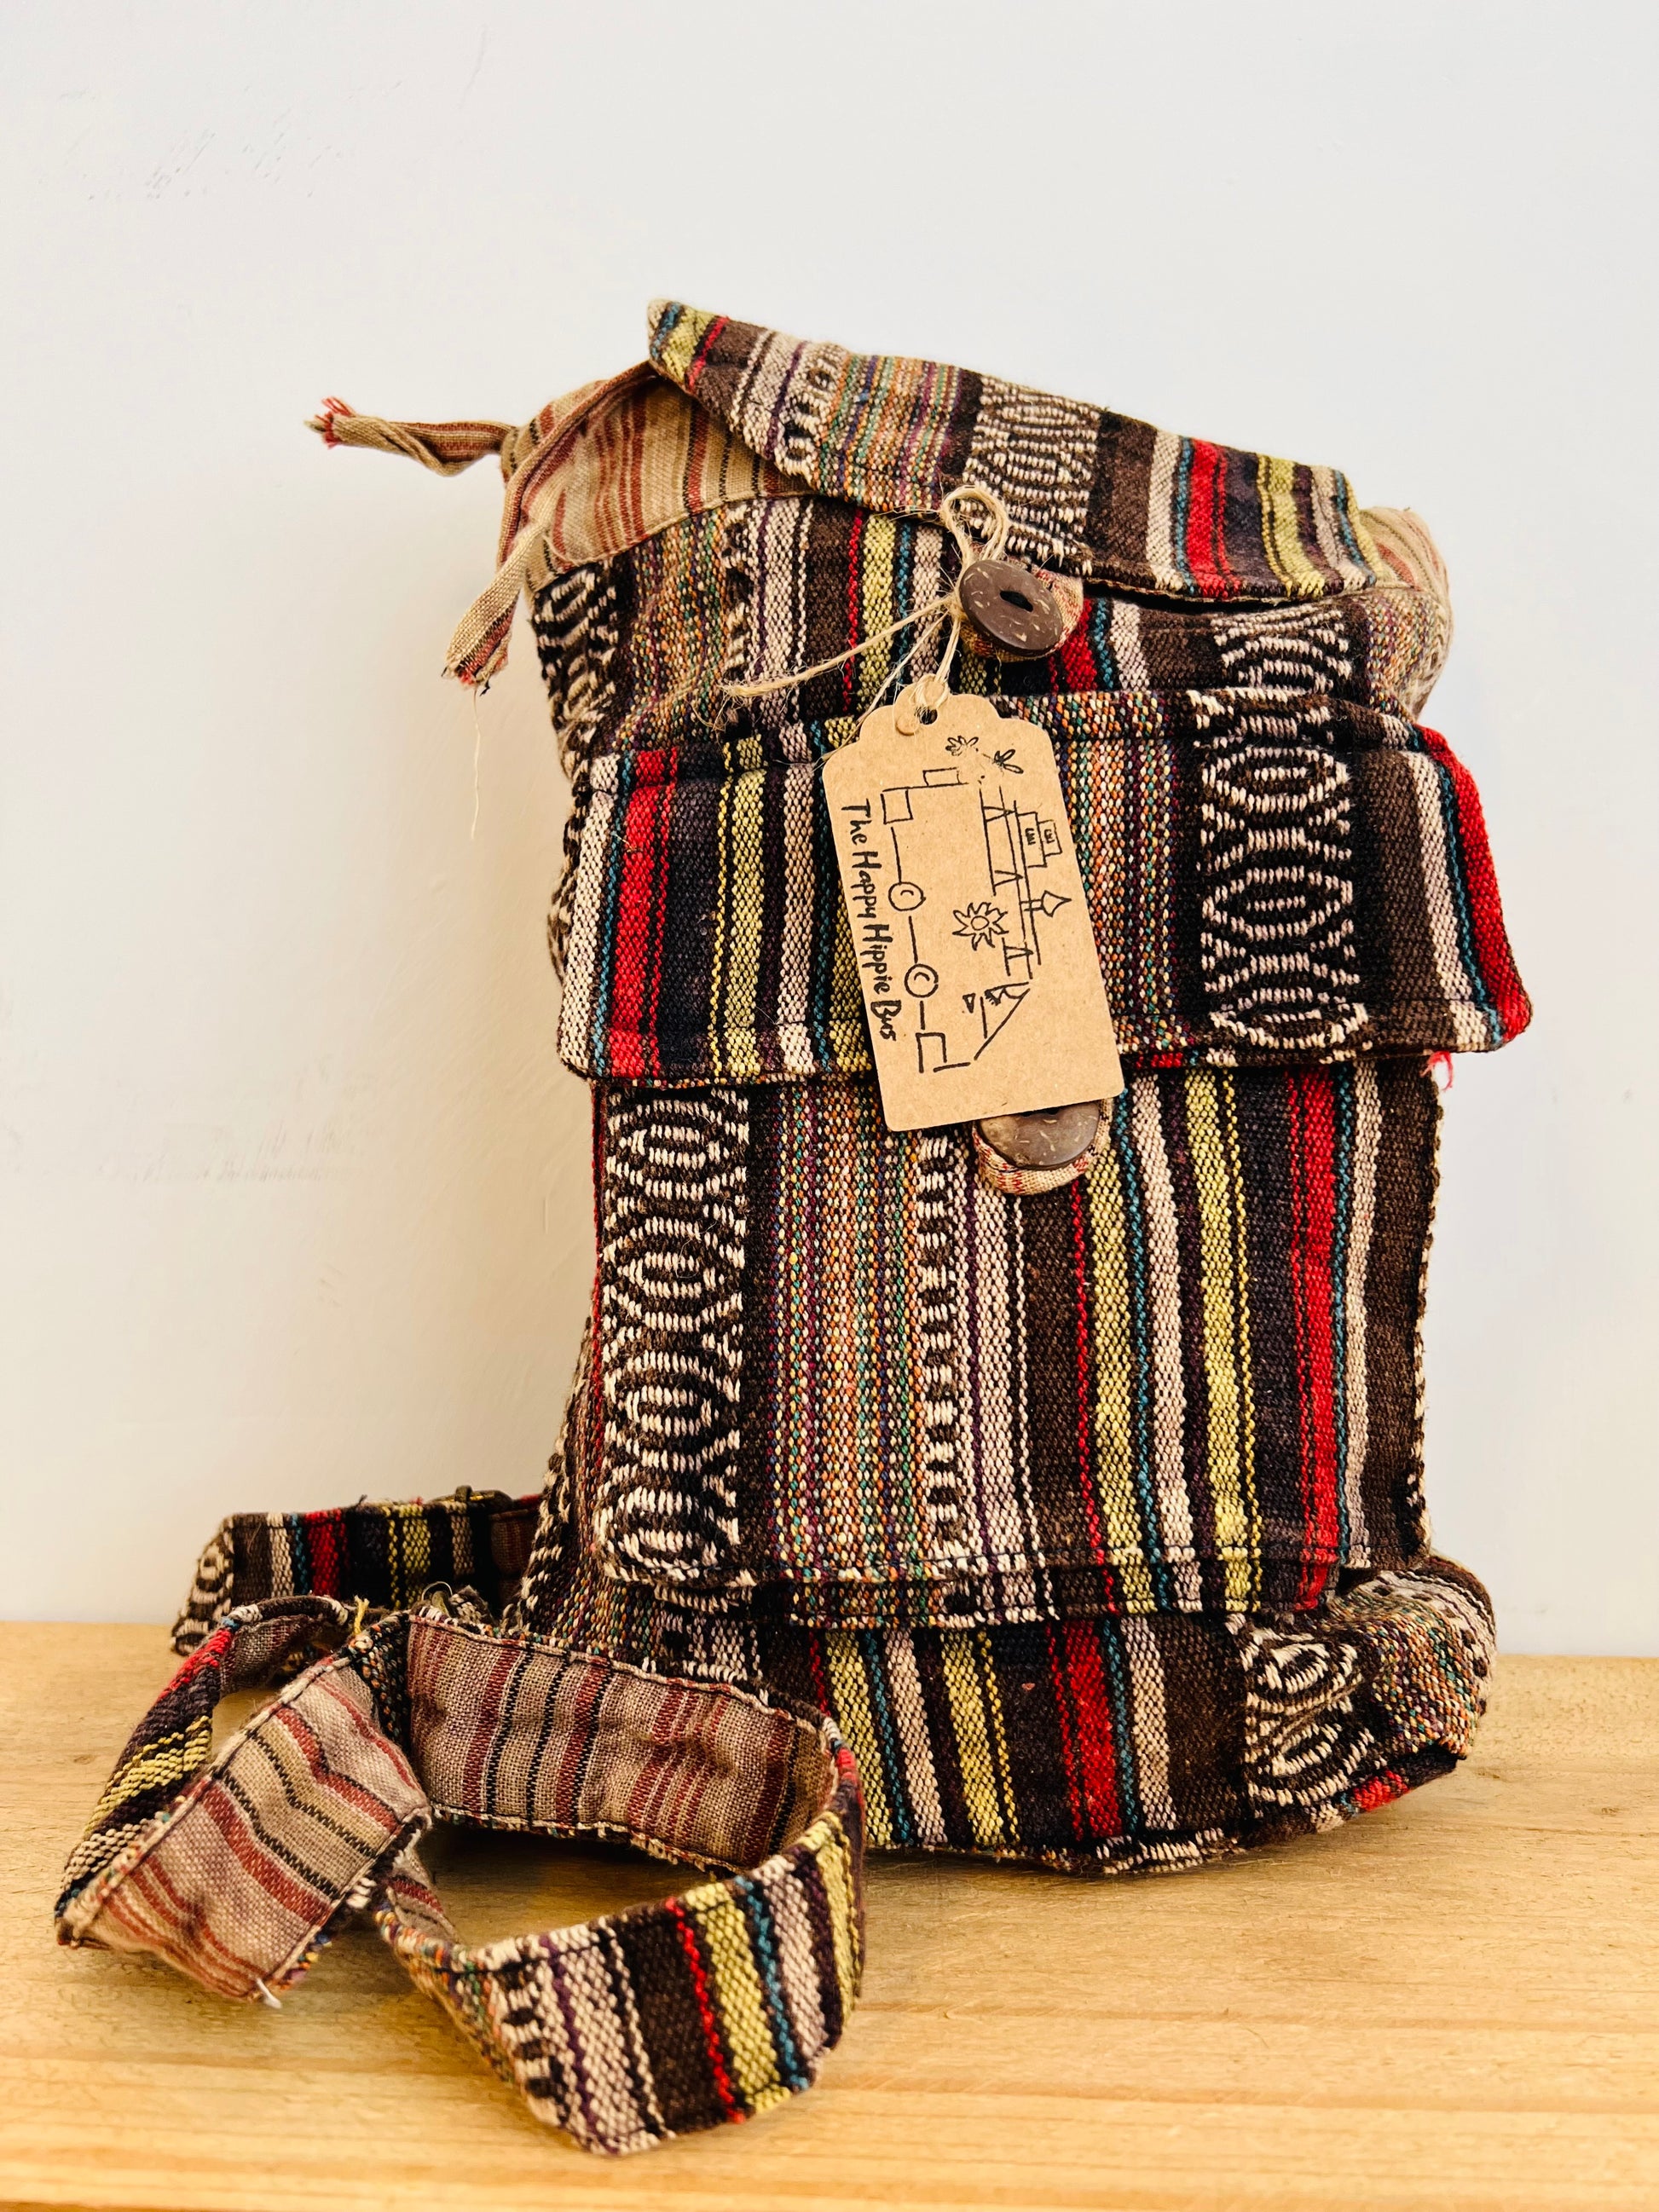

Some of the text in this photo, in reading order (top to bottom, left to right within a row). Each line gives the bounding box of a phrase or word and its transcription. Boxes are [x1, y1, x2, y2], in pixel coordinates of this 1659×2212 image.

[841, 798, 903, 1042] The Happy Hippie Bus
